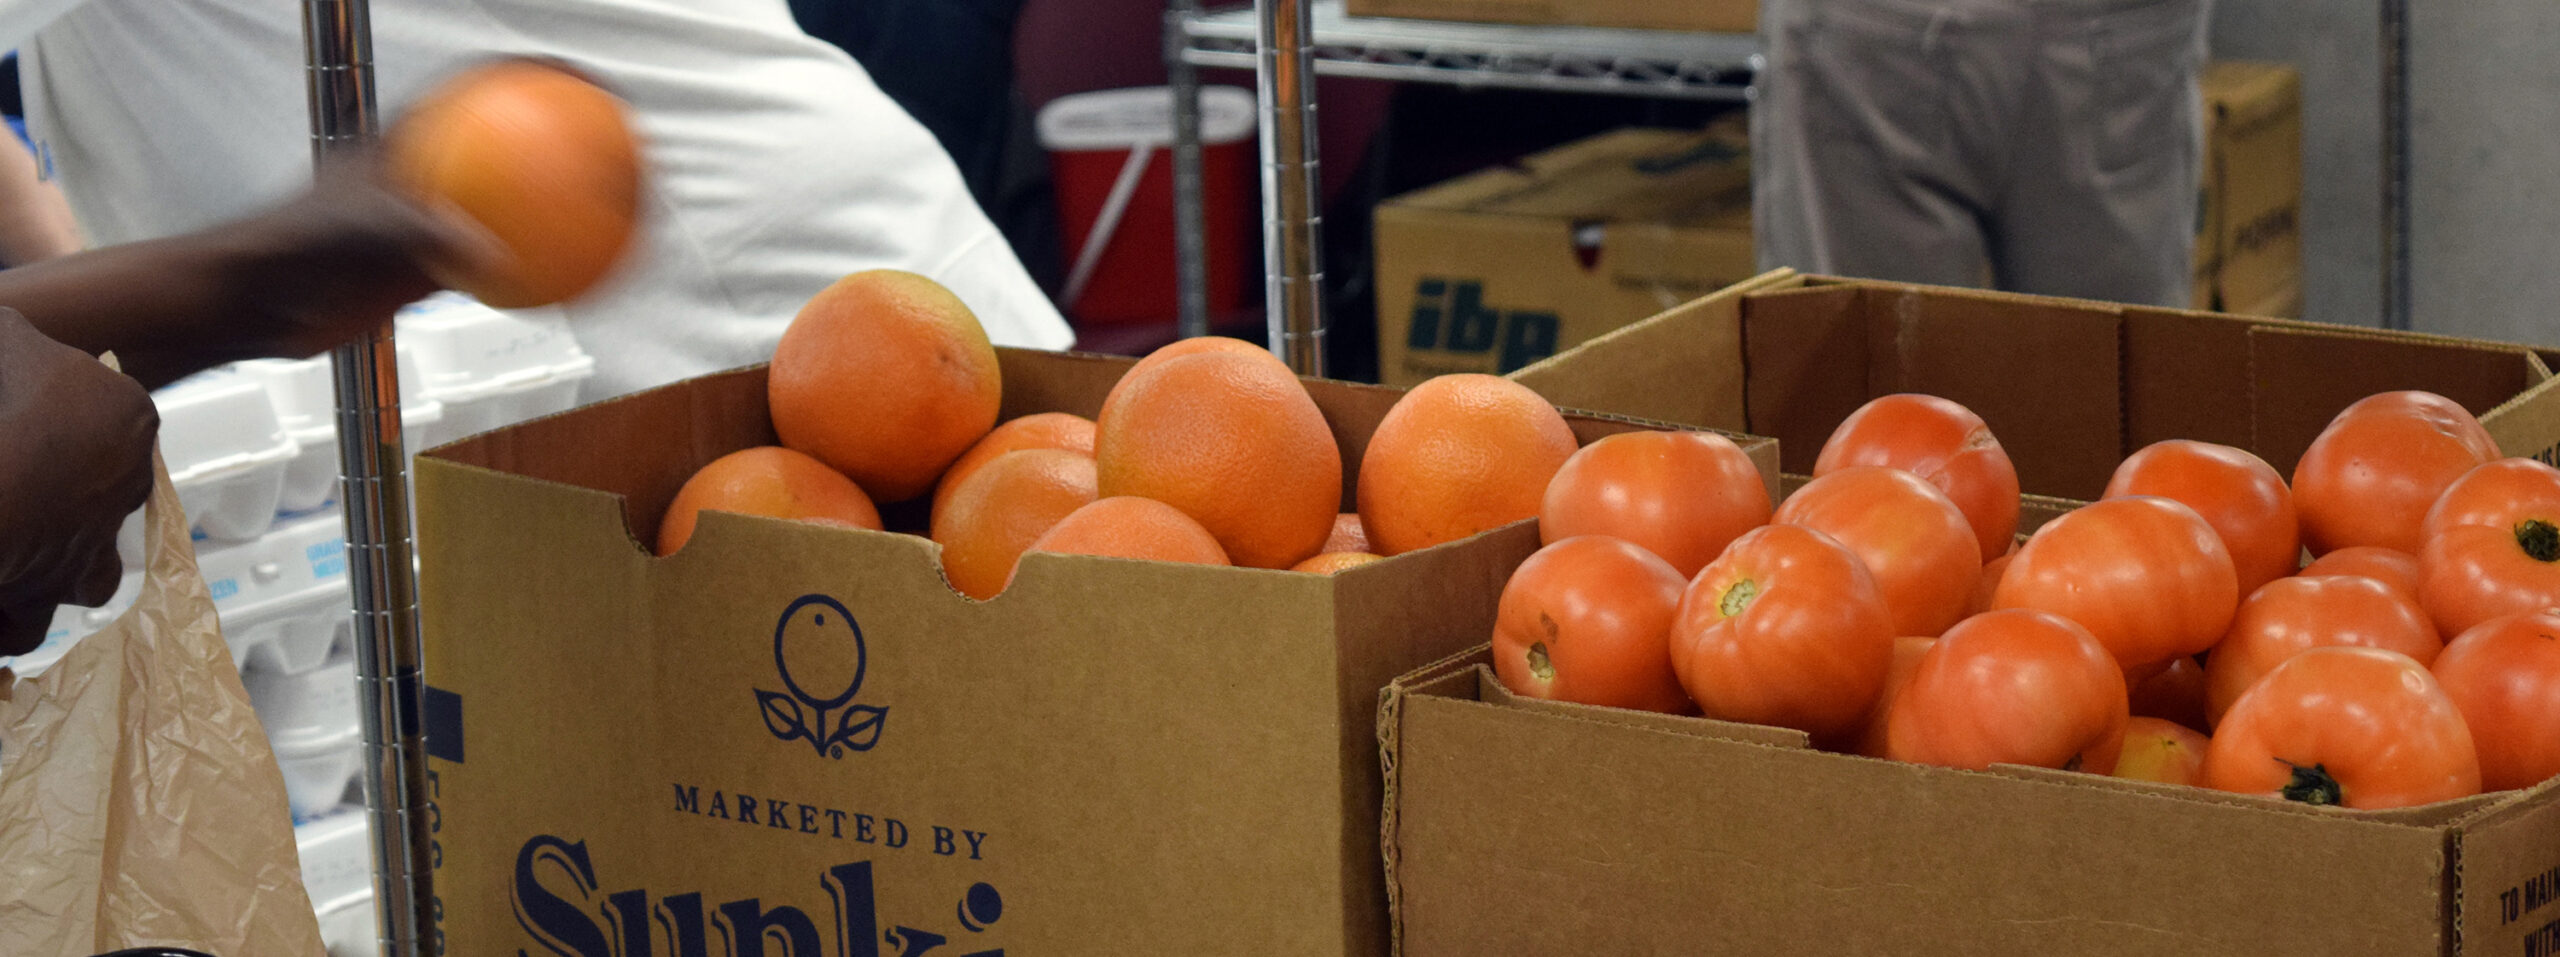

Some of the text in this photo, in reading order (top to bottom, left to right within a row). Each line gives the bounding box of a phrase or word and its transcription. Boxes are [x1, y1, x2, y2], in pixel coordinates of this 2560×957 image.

[1408, 279, 1561, 376] ibp
[306, 537, 346, 562] GRAD
[673, 783, 988, 861] MARKETED BY
[2500, 886, 2519, 926] TO
